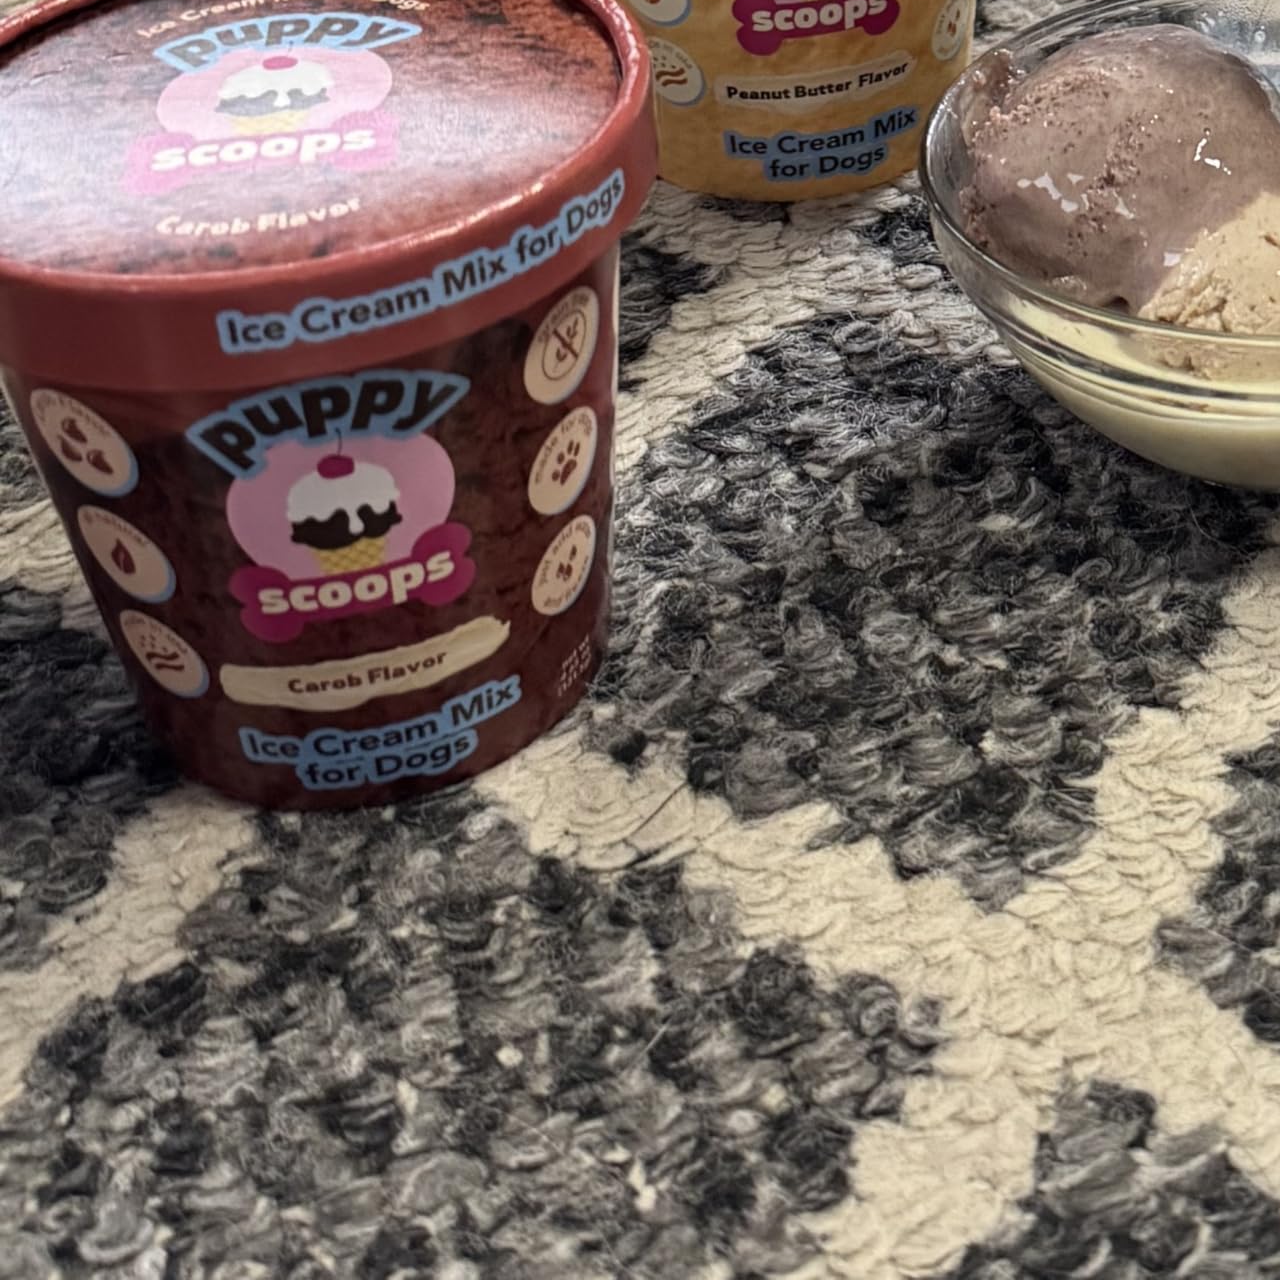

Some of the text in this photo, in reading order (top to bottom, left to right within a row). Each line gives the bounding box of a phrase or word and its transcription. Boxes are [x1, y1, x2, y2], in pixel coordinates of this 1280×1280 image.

[137, 20, 171, 38] Ice
[175, 17, 408, 67] puppy
[727, 63, 909, 100] Peanut Butter Flavor
[150, 127, 376, 172] scoops
[730, 110, 916, 154] Ice Cream Mix
[769, 145, 885, 178] for Dogs
[156, 199, 361, 237] Carob Flavor
[227, 175, 623, 348] Ice Cream Mix for Dogs
[199, 376, 458, 470] puppy
[257, 549, 455, 615] scoops
[288, 649, 447, 695] Carob Flavor
[249, 684, 514, 759] Ice Cream Mix
[306, 734, 471, 786] for Dogs
